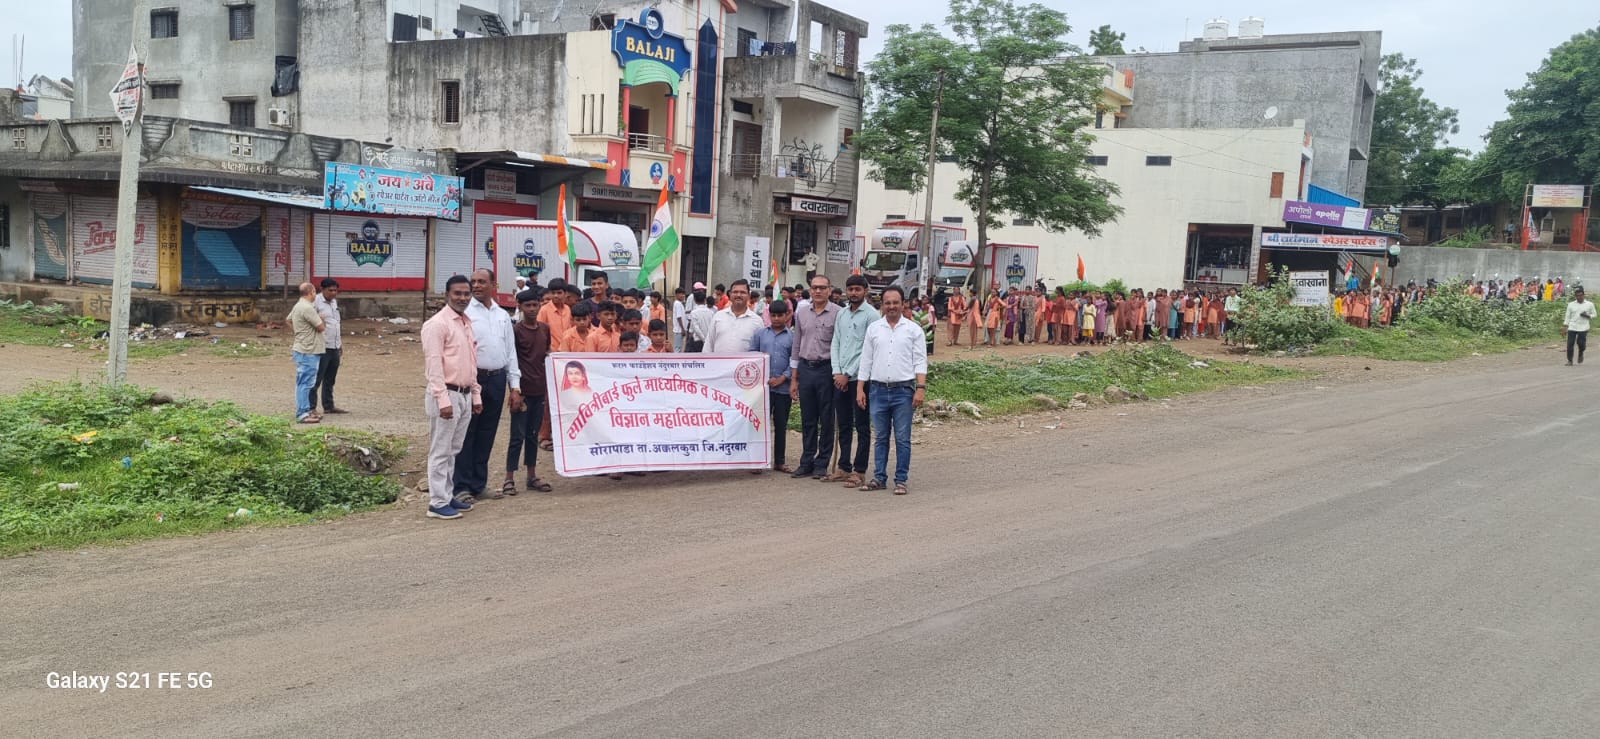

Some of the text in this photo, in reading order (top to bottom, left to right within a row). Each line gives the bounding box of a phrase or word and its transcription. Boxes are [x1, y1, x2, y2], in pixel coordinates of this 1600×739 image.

[626, 36, 676, 63] BALAJI
[378, 174, 403, 189] जय
[800, 200, 840, 214] दवाखाना
[1315, 209, 1340, 219] apollo
[351, 242, 390, 255] BALAJI
[568, 373, 761, 440] सावित्रीबाई फुले माध्यमिक व उच्च माध्य
[609, 406, 725, 429] विज्ञान महाविद्यालय
[589, 443, 634, 457] सोरापाडा
